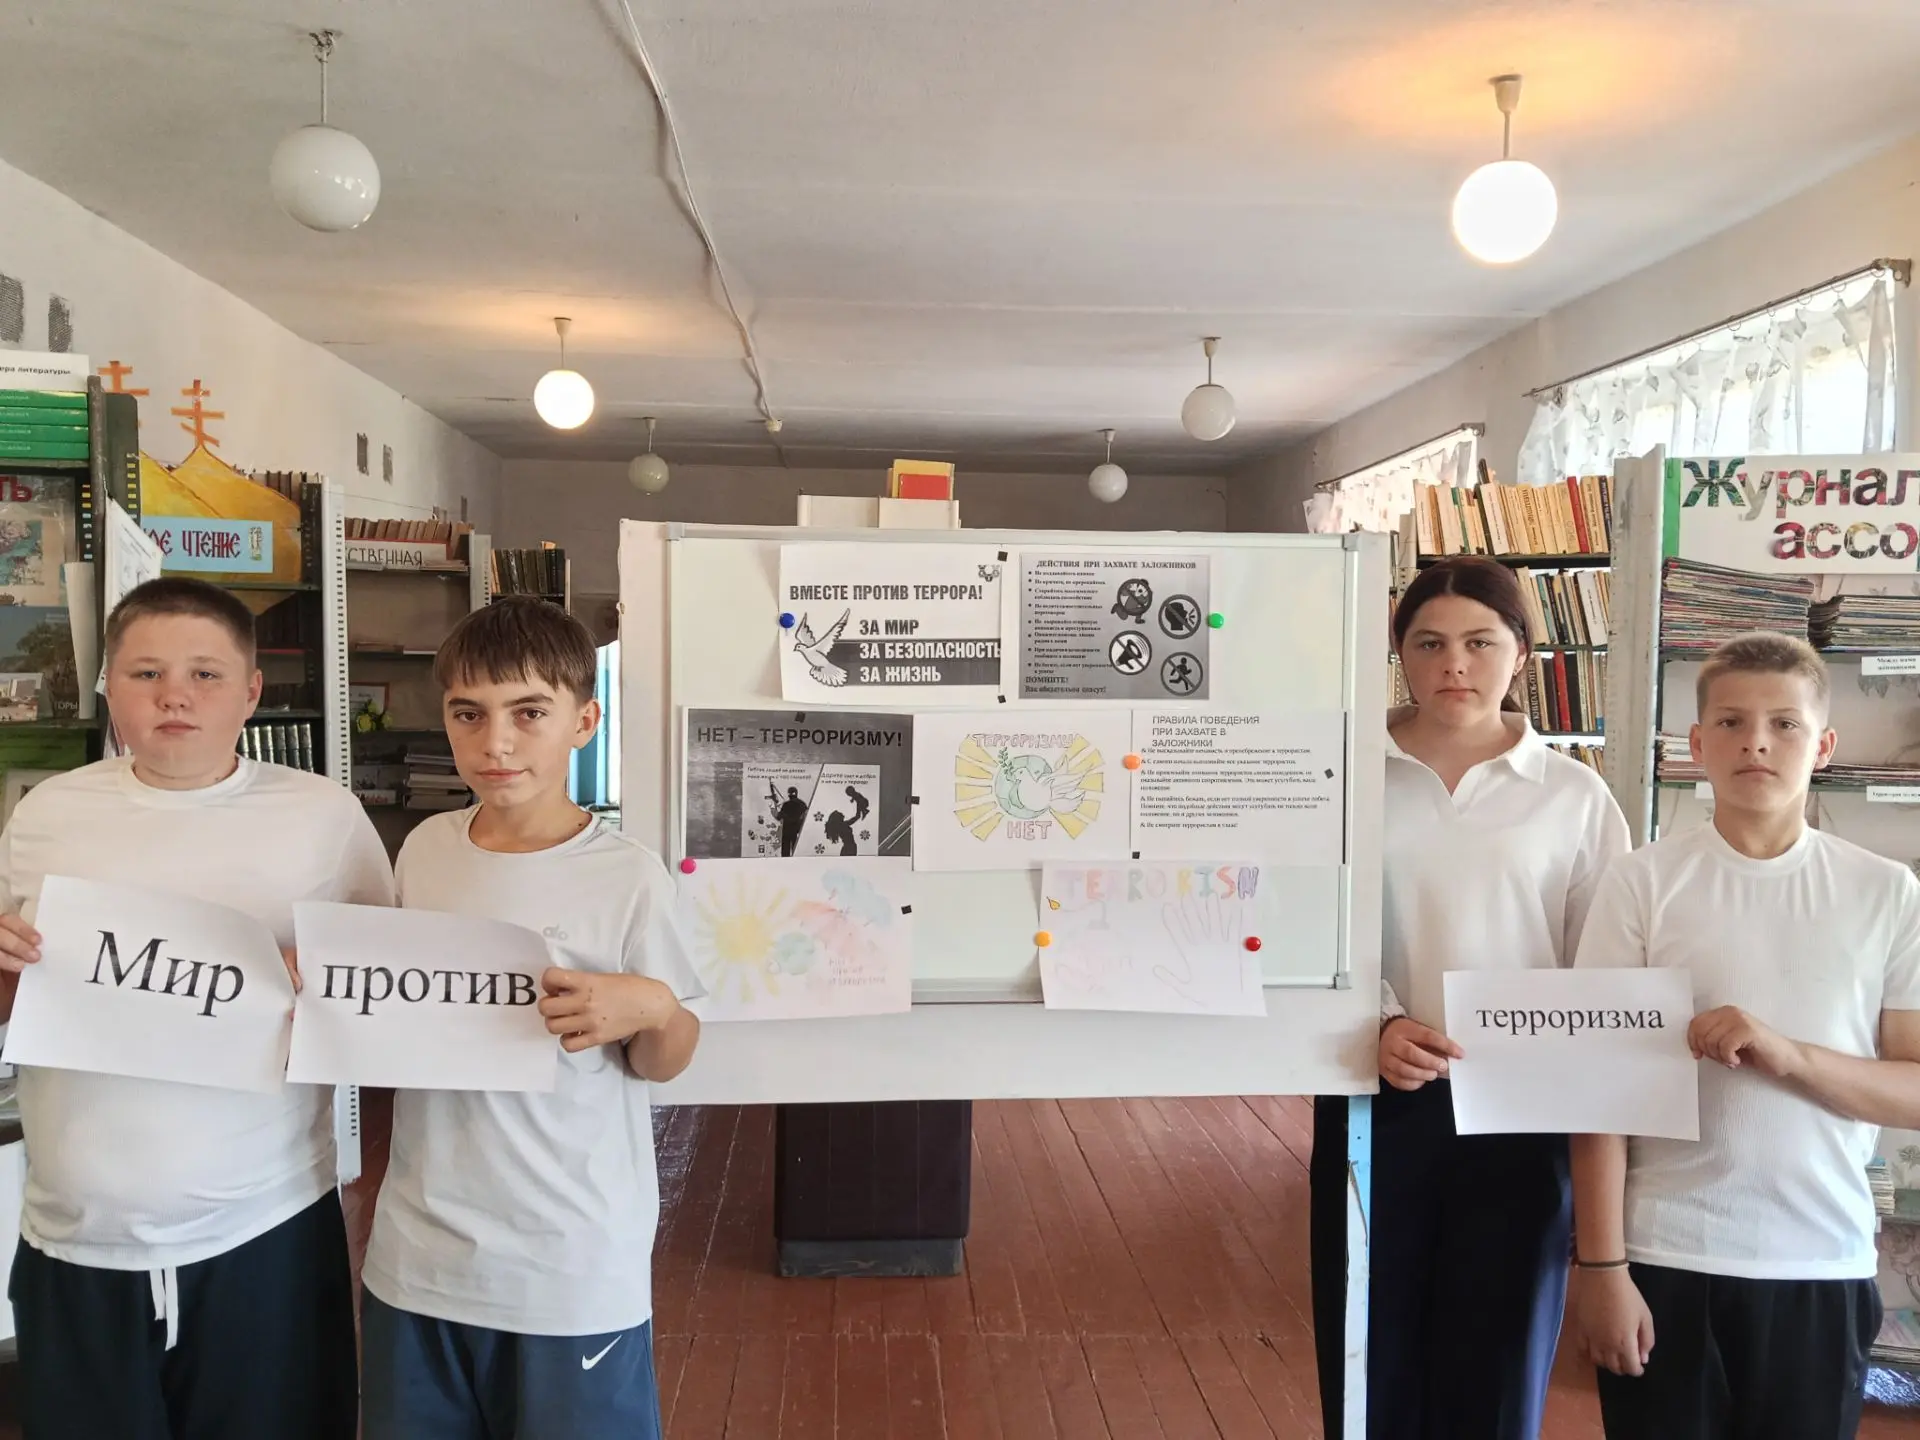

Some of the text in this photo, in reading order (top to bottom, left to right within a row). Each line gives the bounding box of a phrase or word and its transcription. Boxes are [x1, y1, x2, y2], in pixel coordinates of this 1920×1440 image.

[1773, 521, 1920, 560] ассо
[344, 547, 423, 566] СТВЕННАЯ
[1036, 560, 1197, 570] ДЕЙСТВИЯ ПРИ ЗАХВАТЕ ЗАЛОЖНИКОВ
[789, 585, 983, 601] ВМЕСТЕ ПРОТИВ ТЕРРОРА!
[859, 619, 920, 636] ЗА МИР
[859, 642, 880, 659] ЗА
[859, 666, 942, 682] ЗА ЖИЗНЬ
[1152, 715, 1260, 726] ПРАВИЛА ПОВЕДЕНИЯ
[698, 727, 738, 743] НЕТ
[758, 727, 902, 747] ТЕРРОРИЗМУ!
[972, 733, 1074, 748] ТЕРРОРИЗМУ
[1152, 728, 1226, 736] ПРИ ЗАХВАТЕ В
[1152, 739, 1213, 747] ЗАЛОЖНИКИ
[1007, 820, 1052, 840] НЕТ
[84, 929, 246, 1018] Мир
[321, 963, 538, 1015] против
[1475, 1006, 1666, 1036] терроризма
